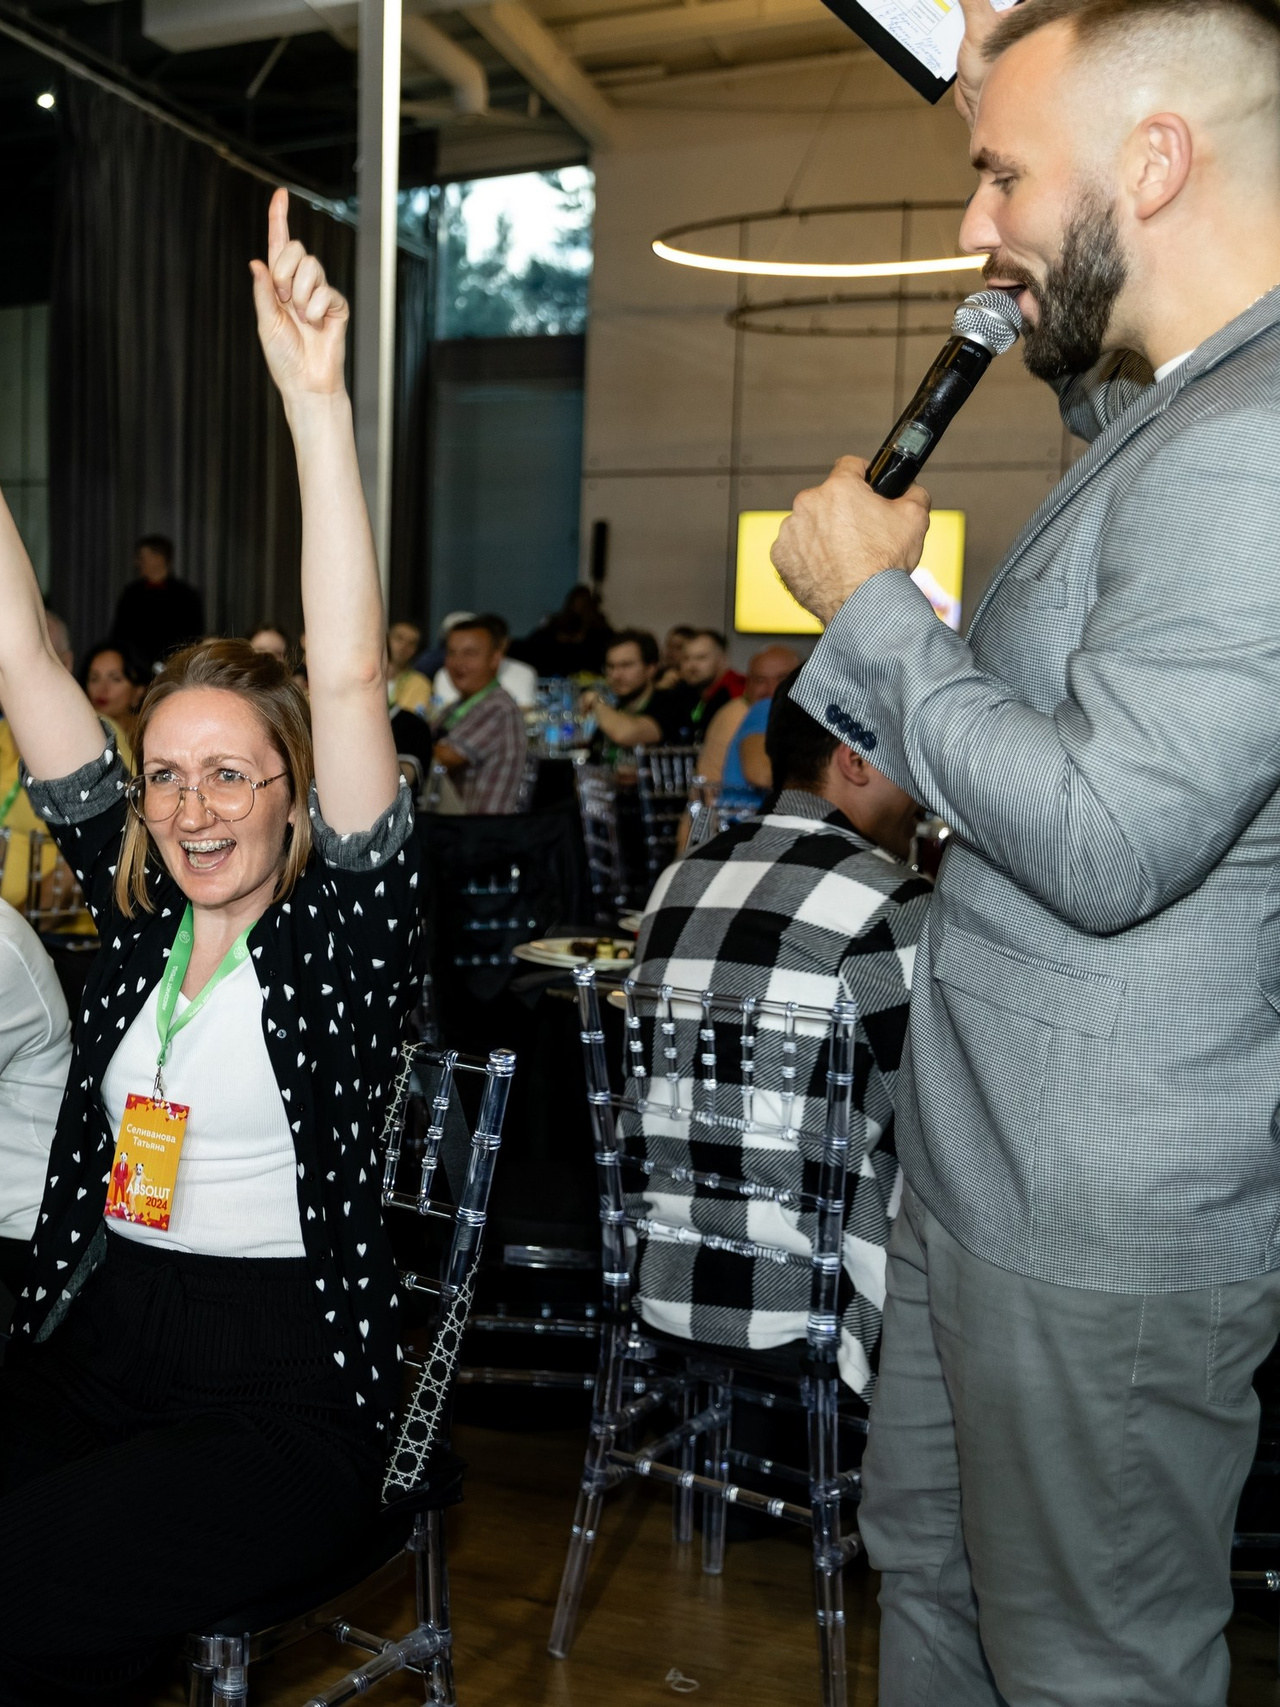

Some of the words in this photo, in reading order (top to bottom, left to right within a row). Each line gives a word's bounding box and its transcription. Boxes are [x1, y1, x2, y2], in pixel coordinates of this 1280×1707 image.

[126, 1123, 176, 1144] Селиванова
[133, 1136, 165, 1153] Татьяна
[126, 1182, 171, 1200] ABSOLUT
[146, 1196, 168, 1211] 2024
